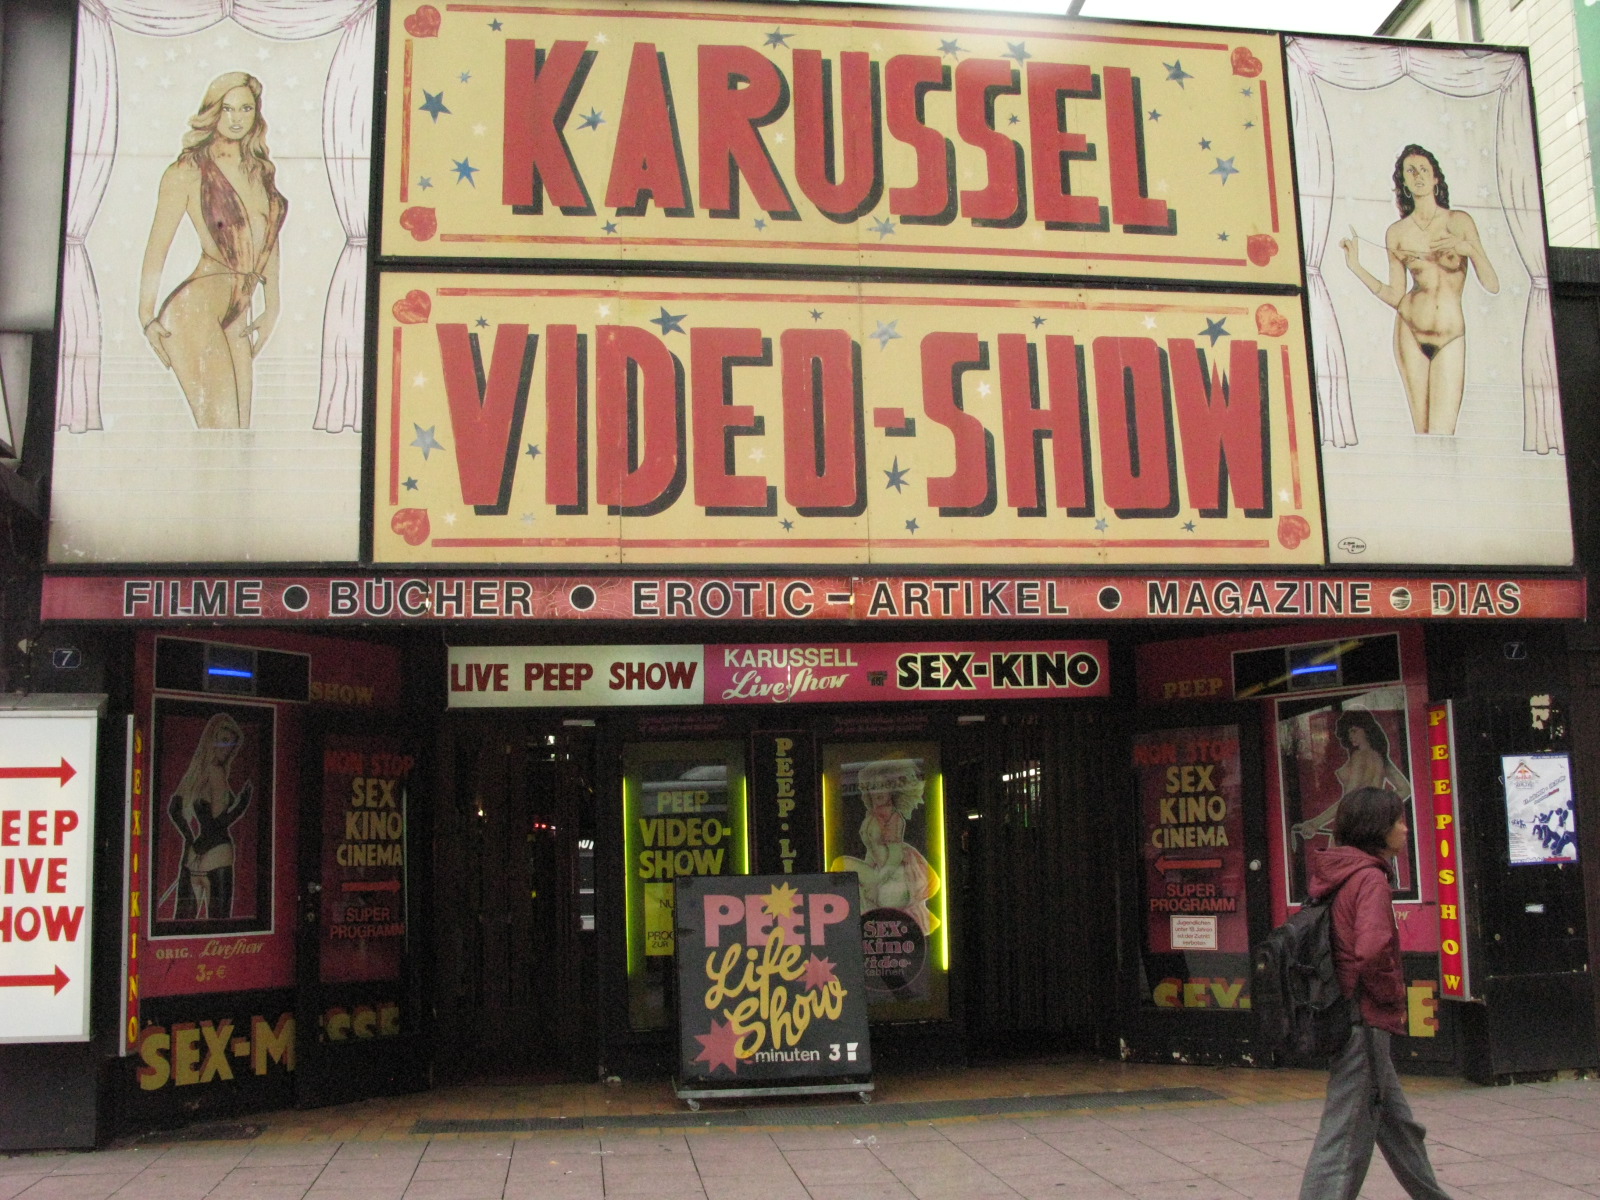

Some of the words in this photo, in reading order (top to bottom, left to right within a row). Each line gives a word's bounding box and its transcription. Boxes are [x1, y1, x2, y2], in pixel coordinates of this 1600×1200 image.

[502, 38, 1177, 236] KARUSSEL
[436, 323, 1275, 519] VIDEO-SHOW
[123, 580, 263, 618] FILME
[329, 577, 534, 619] BÜCHER
[1146, 580, 1373, 618] MAGAZINE
[1431, 581, 1522, 617] DIAS
[62, 650, 74, 667] 7
[723, 647, 859, 669] KARUSSELL
[1510, 642, 1521, 659] 7
[450, 663, 509, 693] LIVE
[524, 662, 594, 693] PEEP
[608, 661, 699, 691] SHOW
[895, 651, 1101, 691] SEX-KINO
[1163, 677, 1224, 700] PEEP
[351, 776, 397, 809] SEX
[1165, 764, 1217, 794] SEX
[657, 790, 710, 813] PEEP
[1160, 795, 1227, 825] KINO
[345, 810, 403, 840] KINO
[638, 817, 732, 848] VIDEO-
[1151, 825, 1229, 849] CINEMA
[336, 843, 404, 867] CINEMA
[638, 848, 725, 879] SHOW
[0, 857, 68, 894] IVE
[1166, 883, 1217, 897] SUPER
[345, 906, 390, 922] SUPER
[1149, 897, 1237, 912] PROGRAMM
[703, 893, 850, 948] PEEP
[704, 926, 809, 1020] Life
[723, 974, 848, 1060] Show
[755, 1048, 820, 1063] minuten
